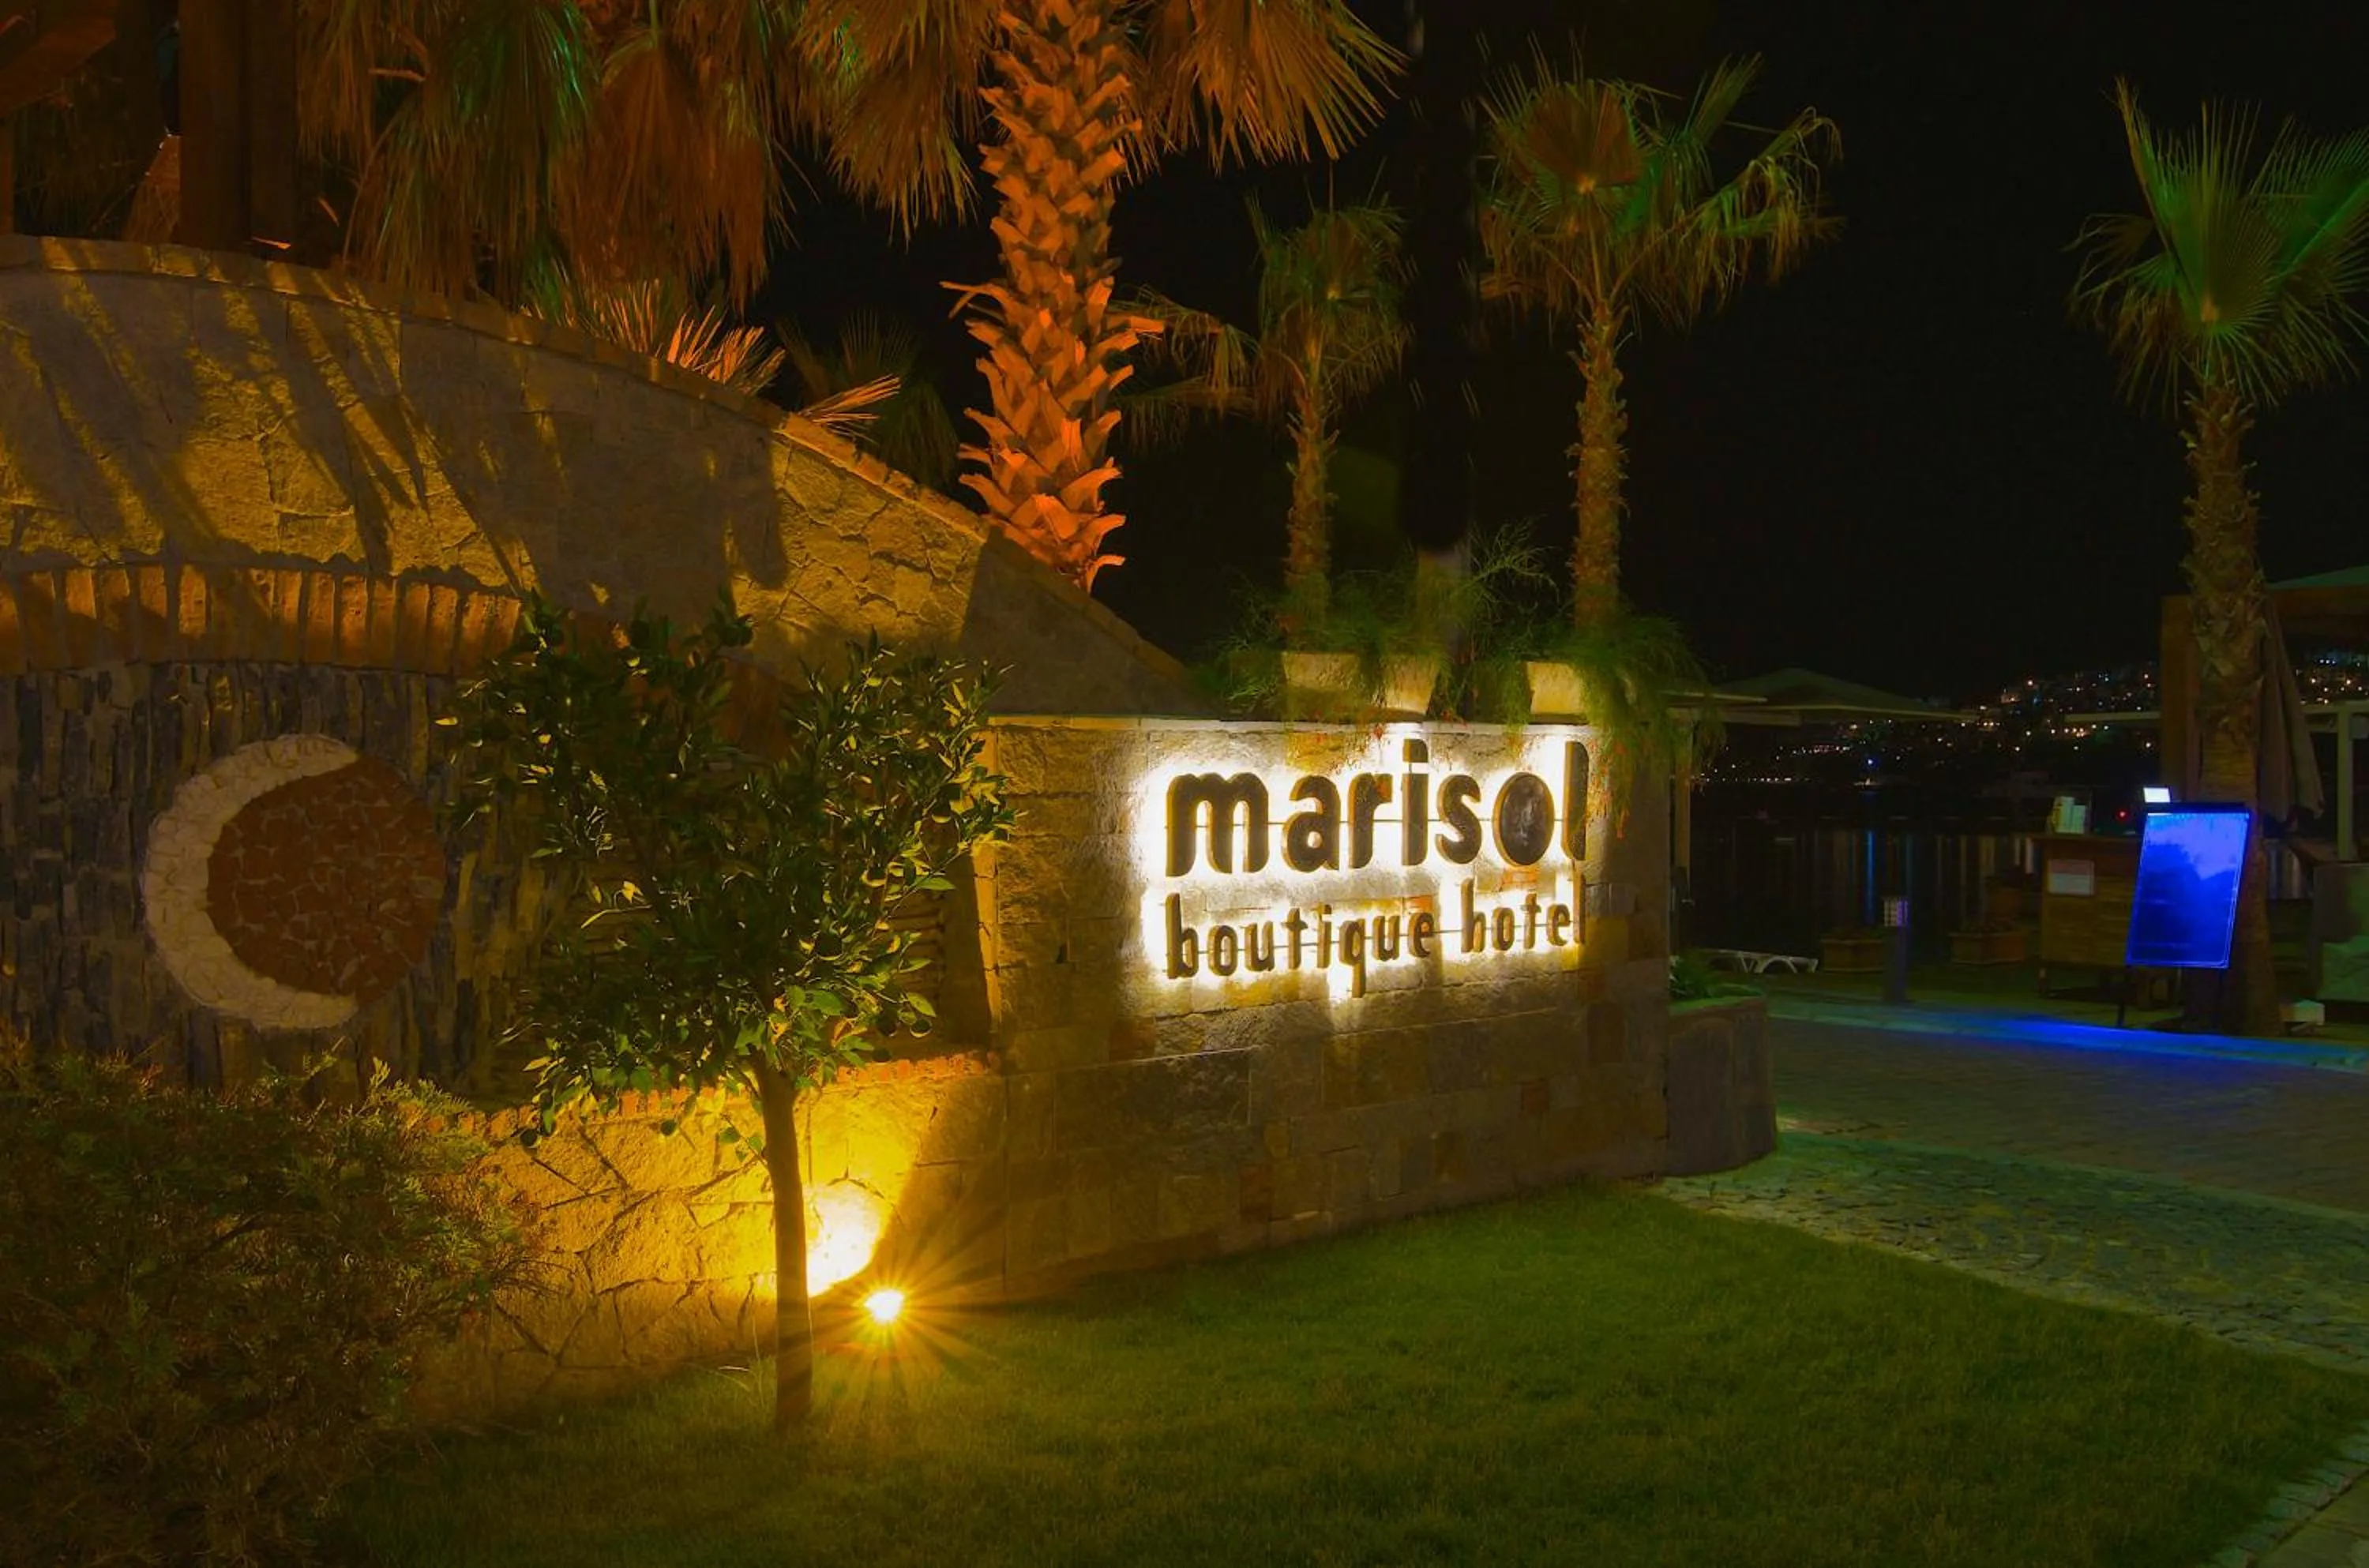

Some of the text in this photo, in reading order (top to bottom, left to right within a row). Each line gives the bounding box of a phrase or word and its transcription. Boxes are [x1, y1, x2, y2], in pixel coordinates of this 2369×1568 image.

[1166, 738, 1590, 877] marisol
[1165, 868, 1586, 999] boutique hotel
